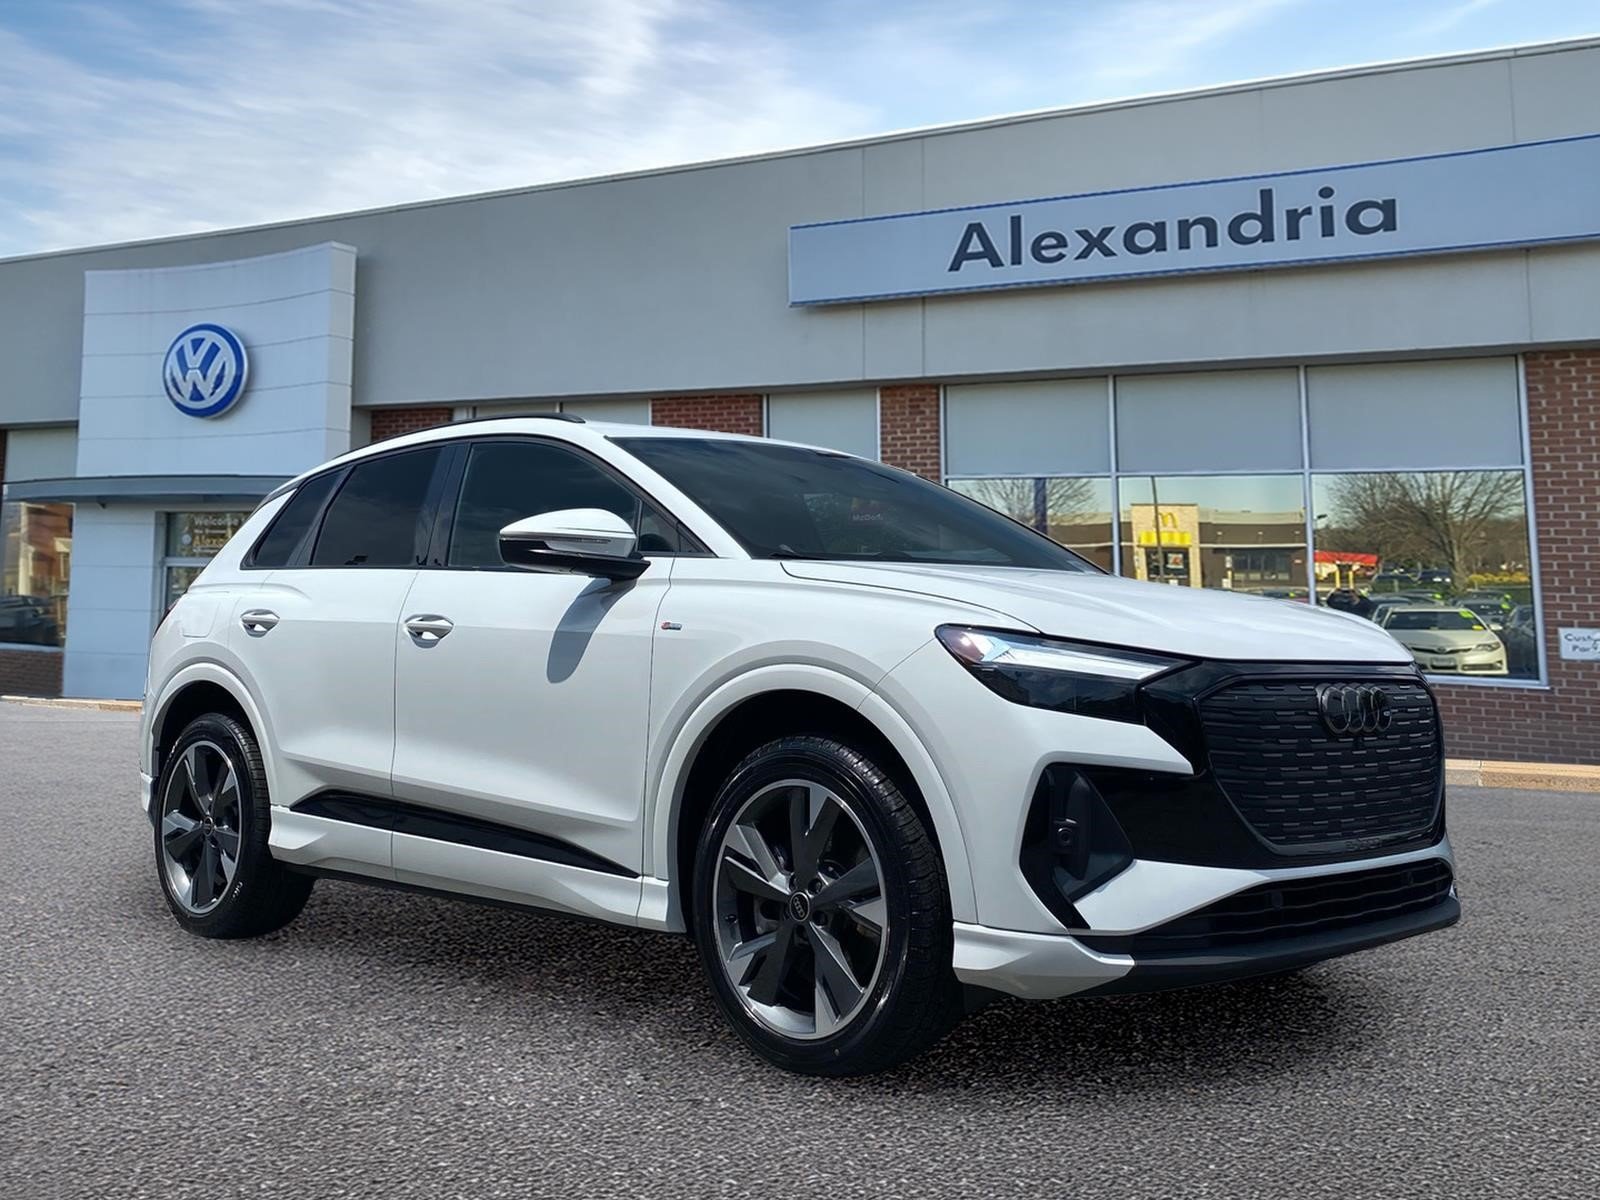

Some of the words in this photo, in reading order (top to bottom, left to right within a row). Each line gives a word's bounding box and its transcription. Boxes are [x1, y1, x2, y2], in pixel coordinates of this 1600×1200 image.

[948, 186, 1397, 273] Alexandria
[164, 327, 241, 413] VW
[1564, 633, 1594, 642] Cust
